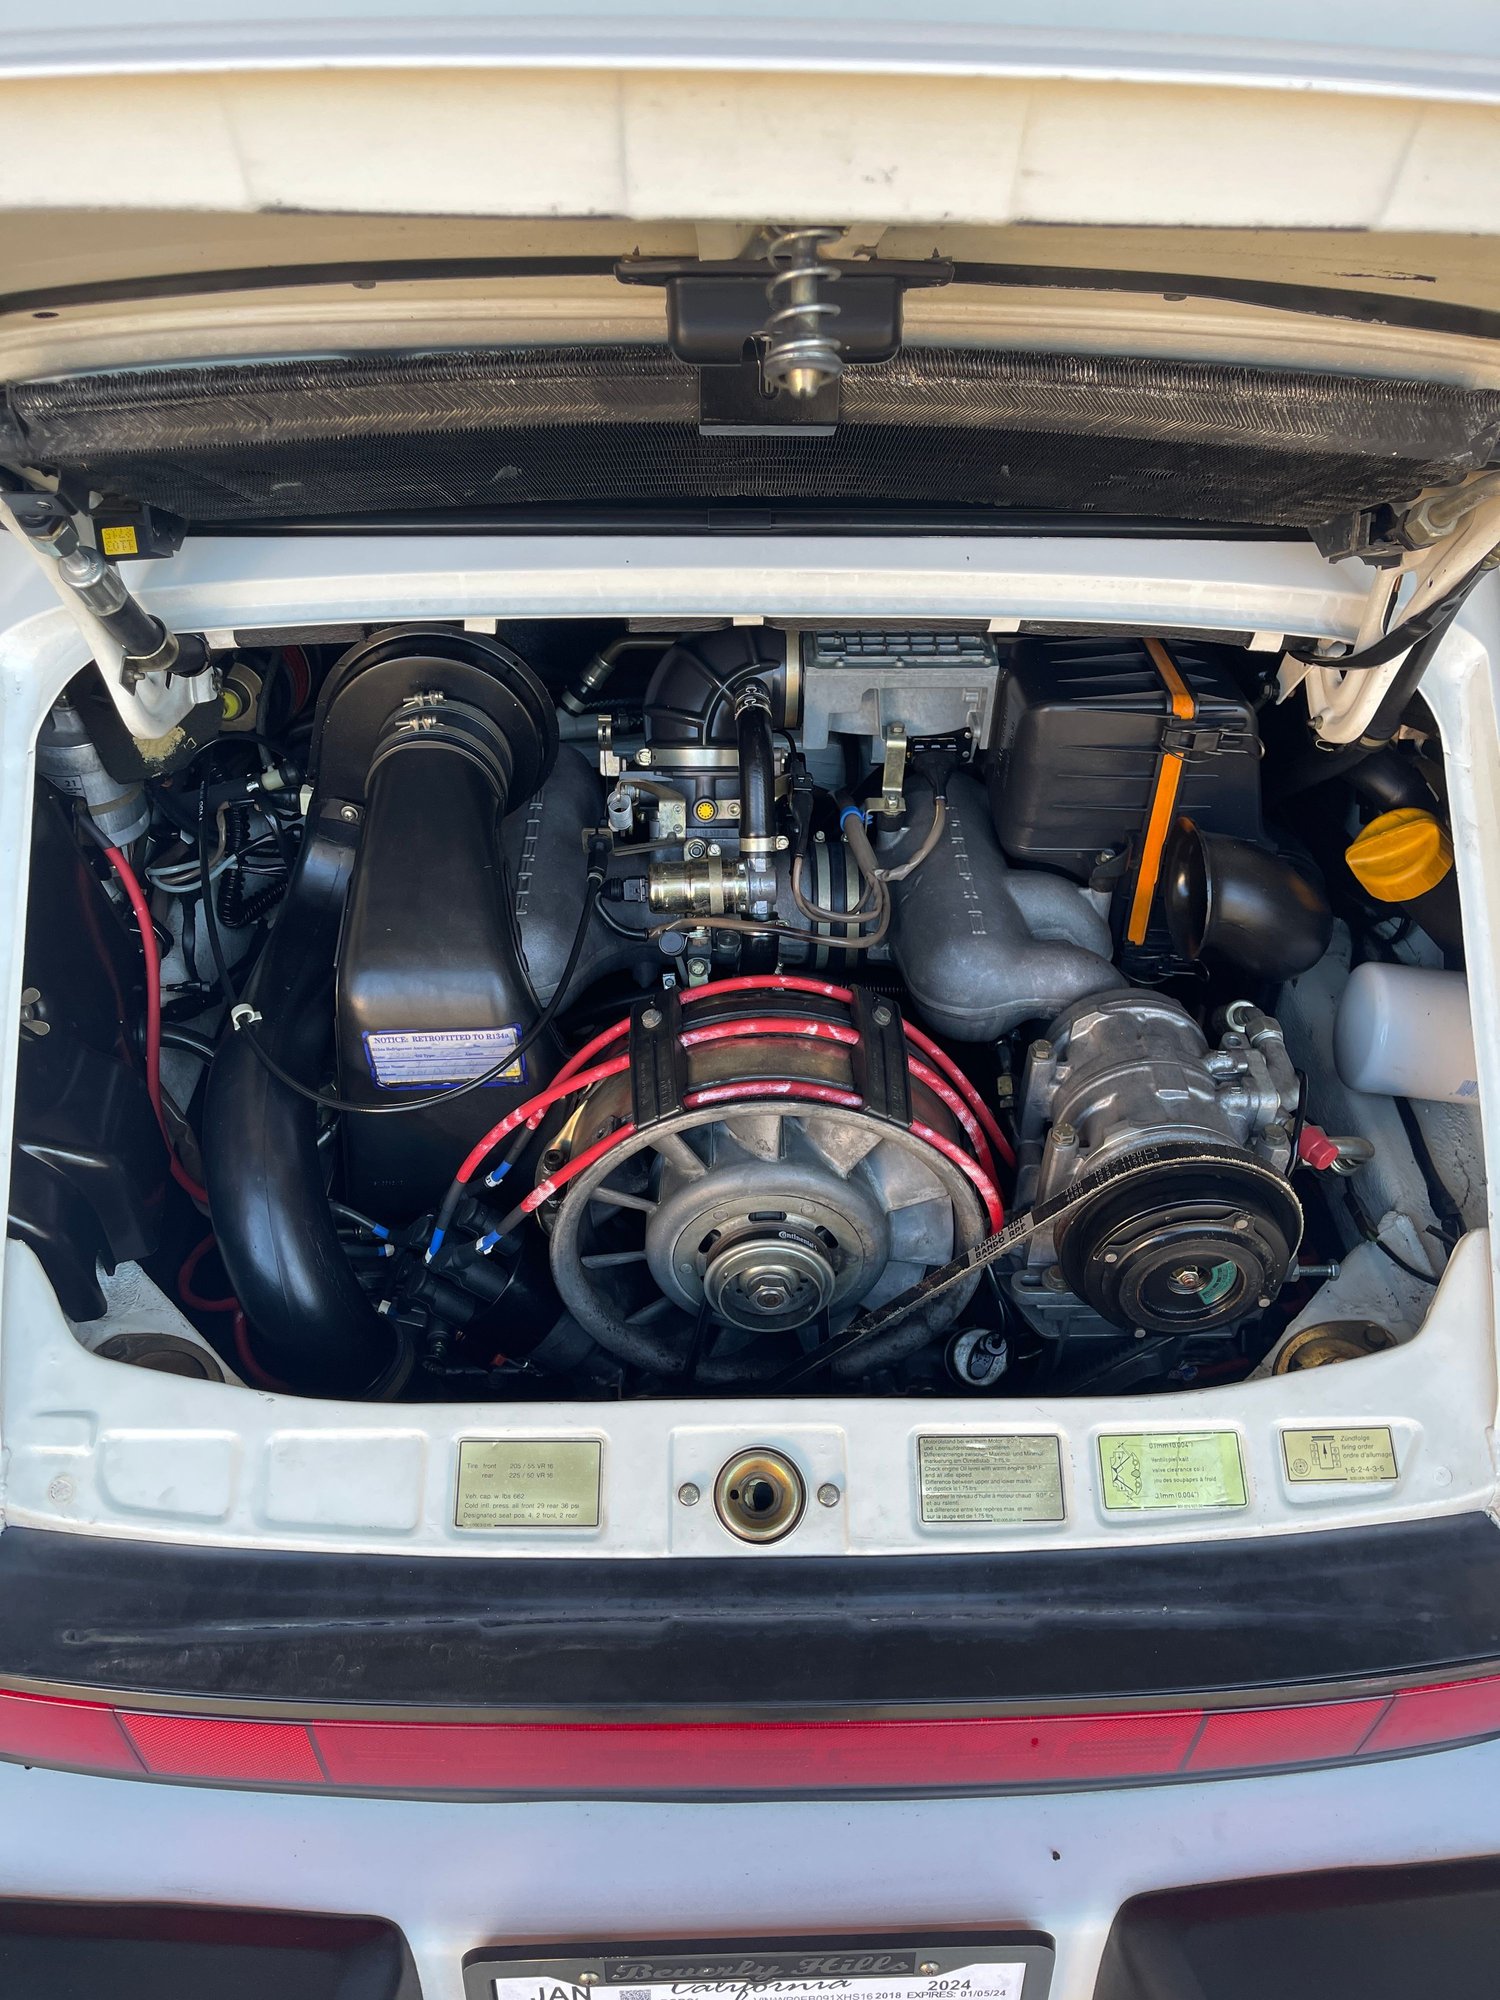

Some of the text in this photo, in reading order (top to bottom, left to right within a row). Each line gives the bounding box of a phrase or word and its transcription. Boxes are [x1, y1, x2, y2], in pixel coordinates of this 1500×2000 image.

[412, 1034, 471, 1042] RETROFITTED
[976, 1237, 1005, 1258] BANDO
[1345, 1465, 1384, 1474] 1-6-2-4-3-5
[611, 1955, 909, 1982] Beverly Hills
[530, 1980, 972, 2000] JAN 2024
[960, 1990, 1006, 1998] 01/05/24
